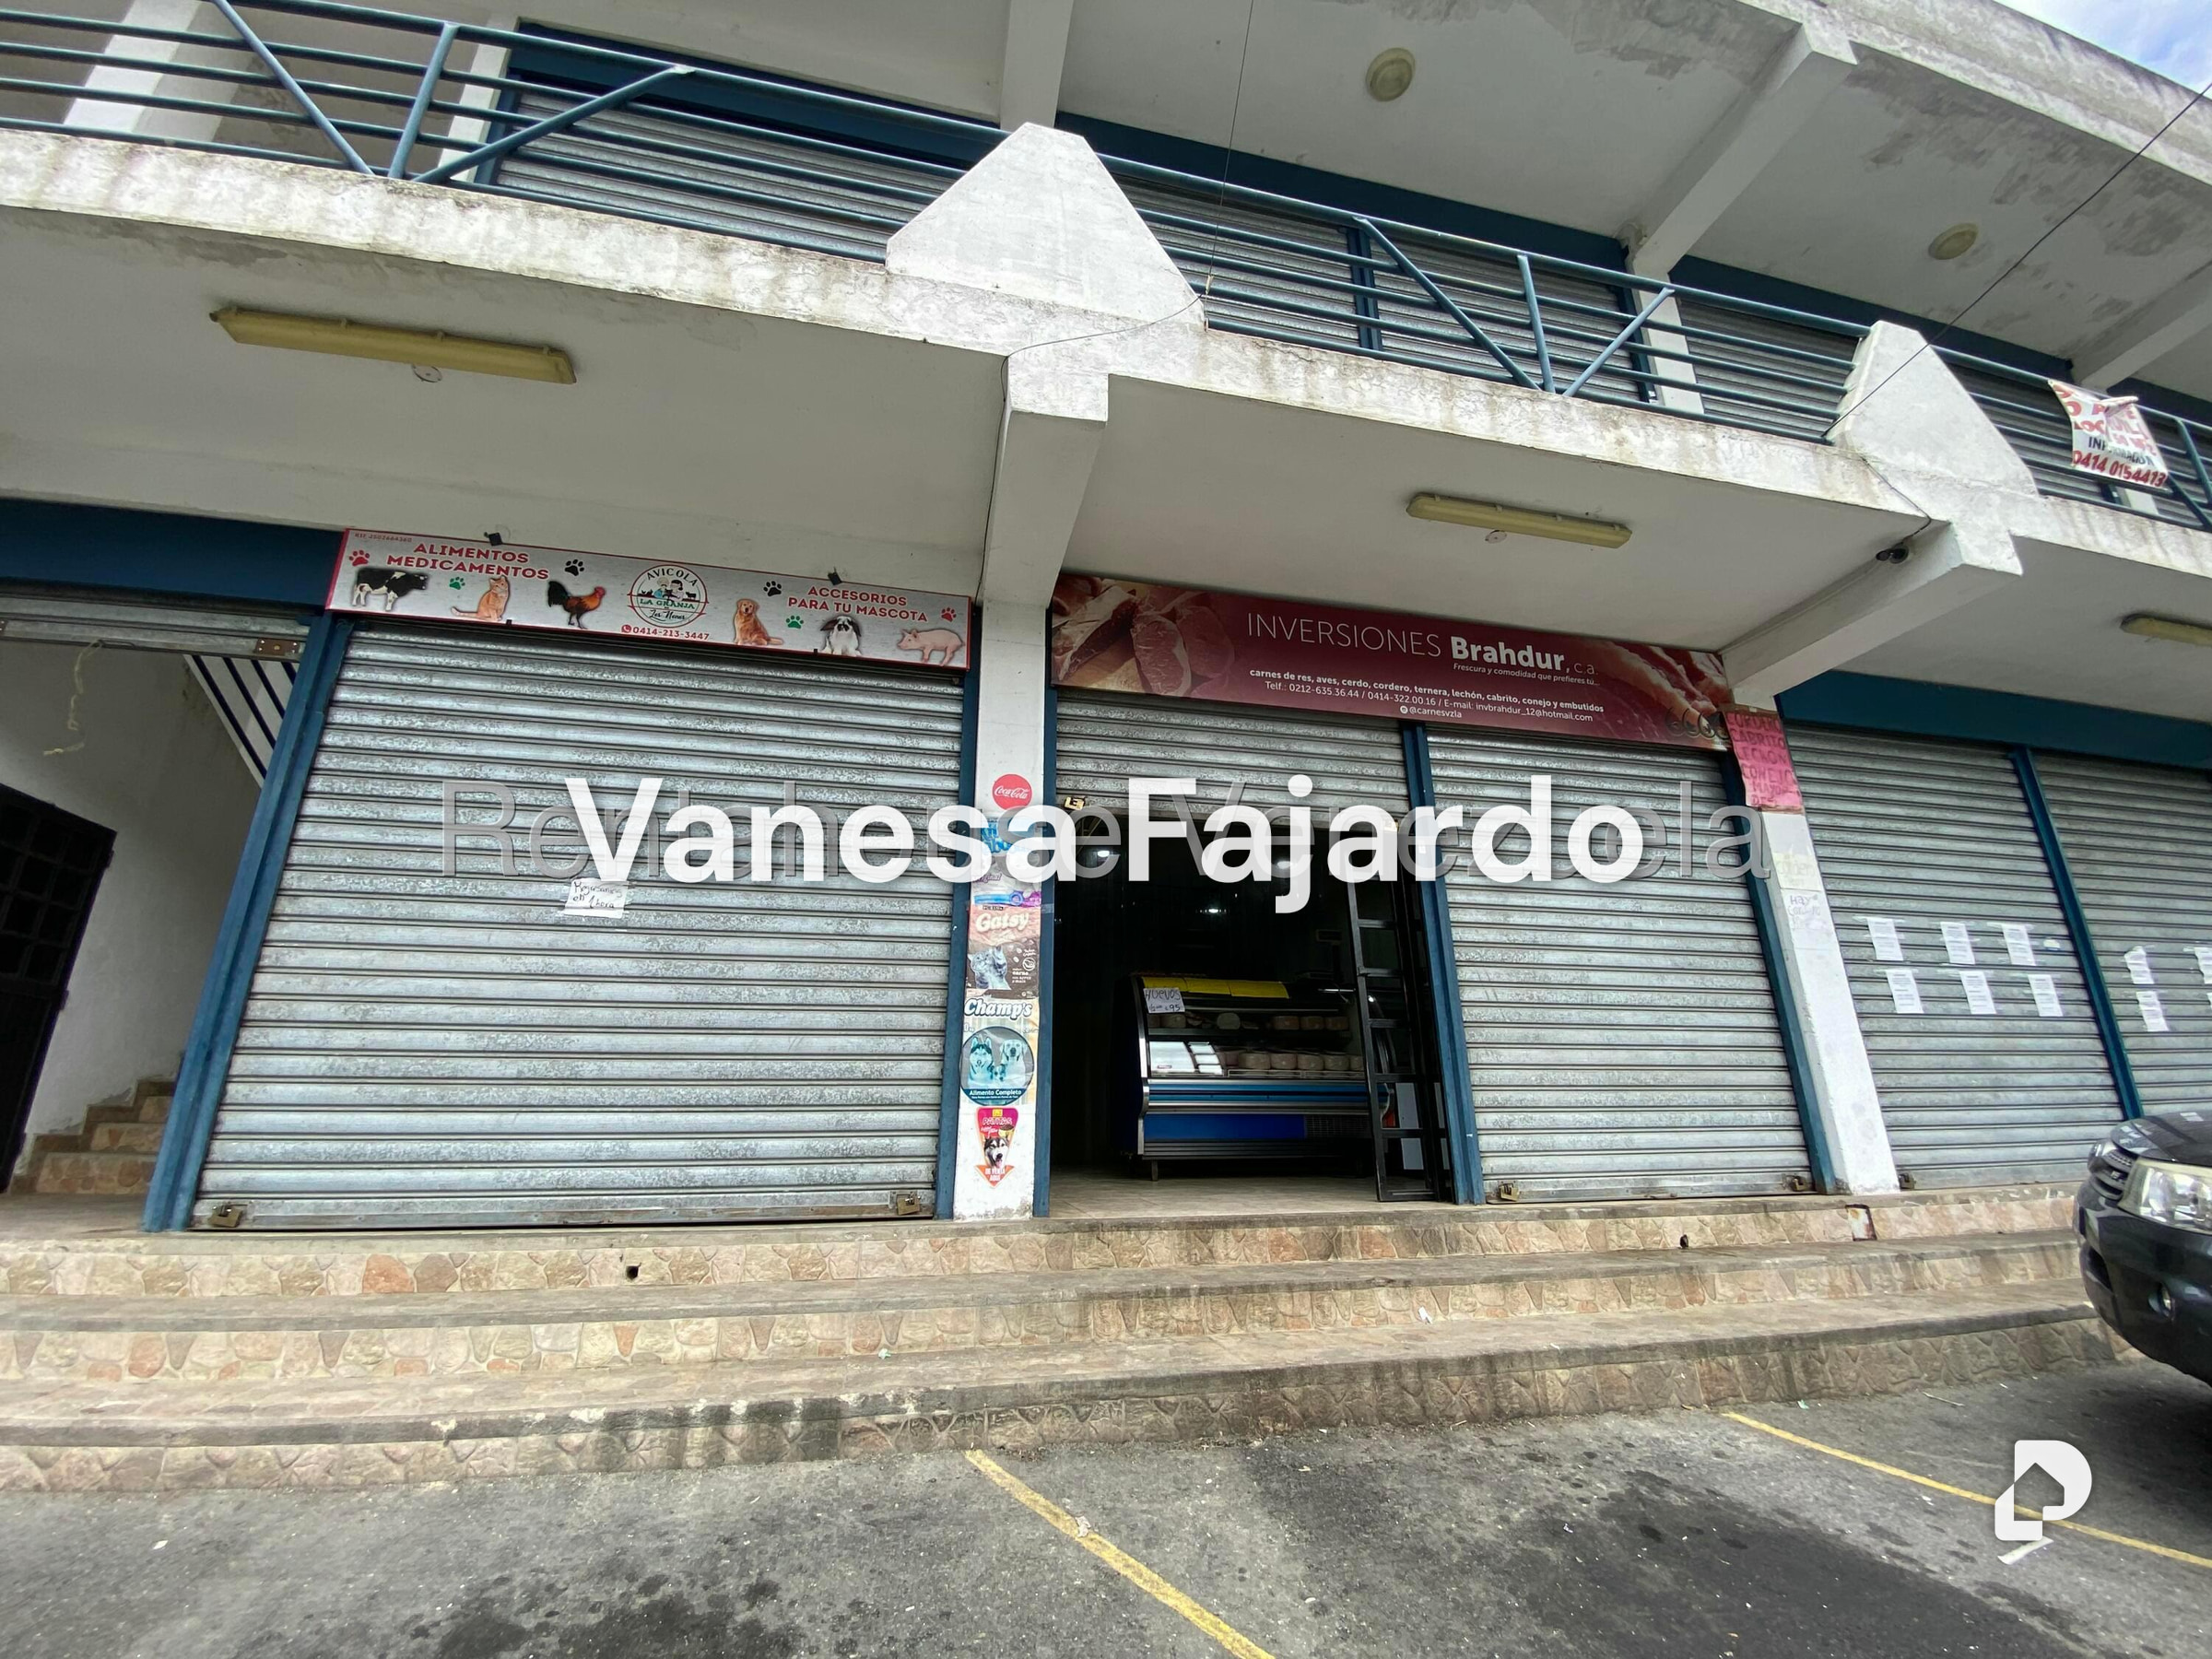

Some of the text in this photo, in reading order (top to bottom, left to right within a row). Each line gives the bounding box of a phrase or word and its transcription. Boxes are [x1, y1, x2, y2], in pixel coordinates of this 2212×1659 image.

[2109, 461, 2167, 487] 0154413
[414, 543, 529, 563] ALIMENTOS
[387, 555, 549, 580] MEDICAMENTOS
[646, 568, 698, 586] AVICOLA
[656, 600, 695, 610] GRANJA
[807, 586, 907, 606] ACCESORIOS
[788, 597, 927, 622] PARA TU MASCOTA
[632, 627, 710, 641] 0414-213-3447
[1248, 612, 1441, 657] INVERSIONES
[1453, 663, 1487, 674] Frescura
[1487, 667, 1493, 676] y
[1493, 668, 1536, 679] comodidad
[1537, 673, 1552, 683] que
[1553, 675, 1586, 685] prefieres
[1249, 669, 1605, 713] carnes de res, aves, cerdo, cordero, ternera, lechón, cabrito, conejo y embutidos
[1288, 683, 1359, 698] 0212-635.36.44
[1367, 691, 1437, 706] 0414-322.00.16
[1444, 699, 1474, 710] E-mail:
[1476, 702, 1594, 723] invbrahdur_12@hotmail.com
[1409, 707, 1463, 719] @carnesvzla
[975, 912, 1030, 934] Gatsy
[964, 997, 1033, 1018] Champ's
